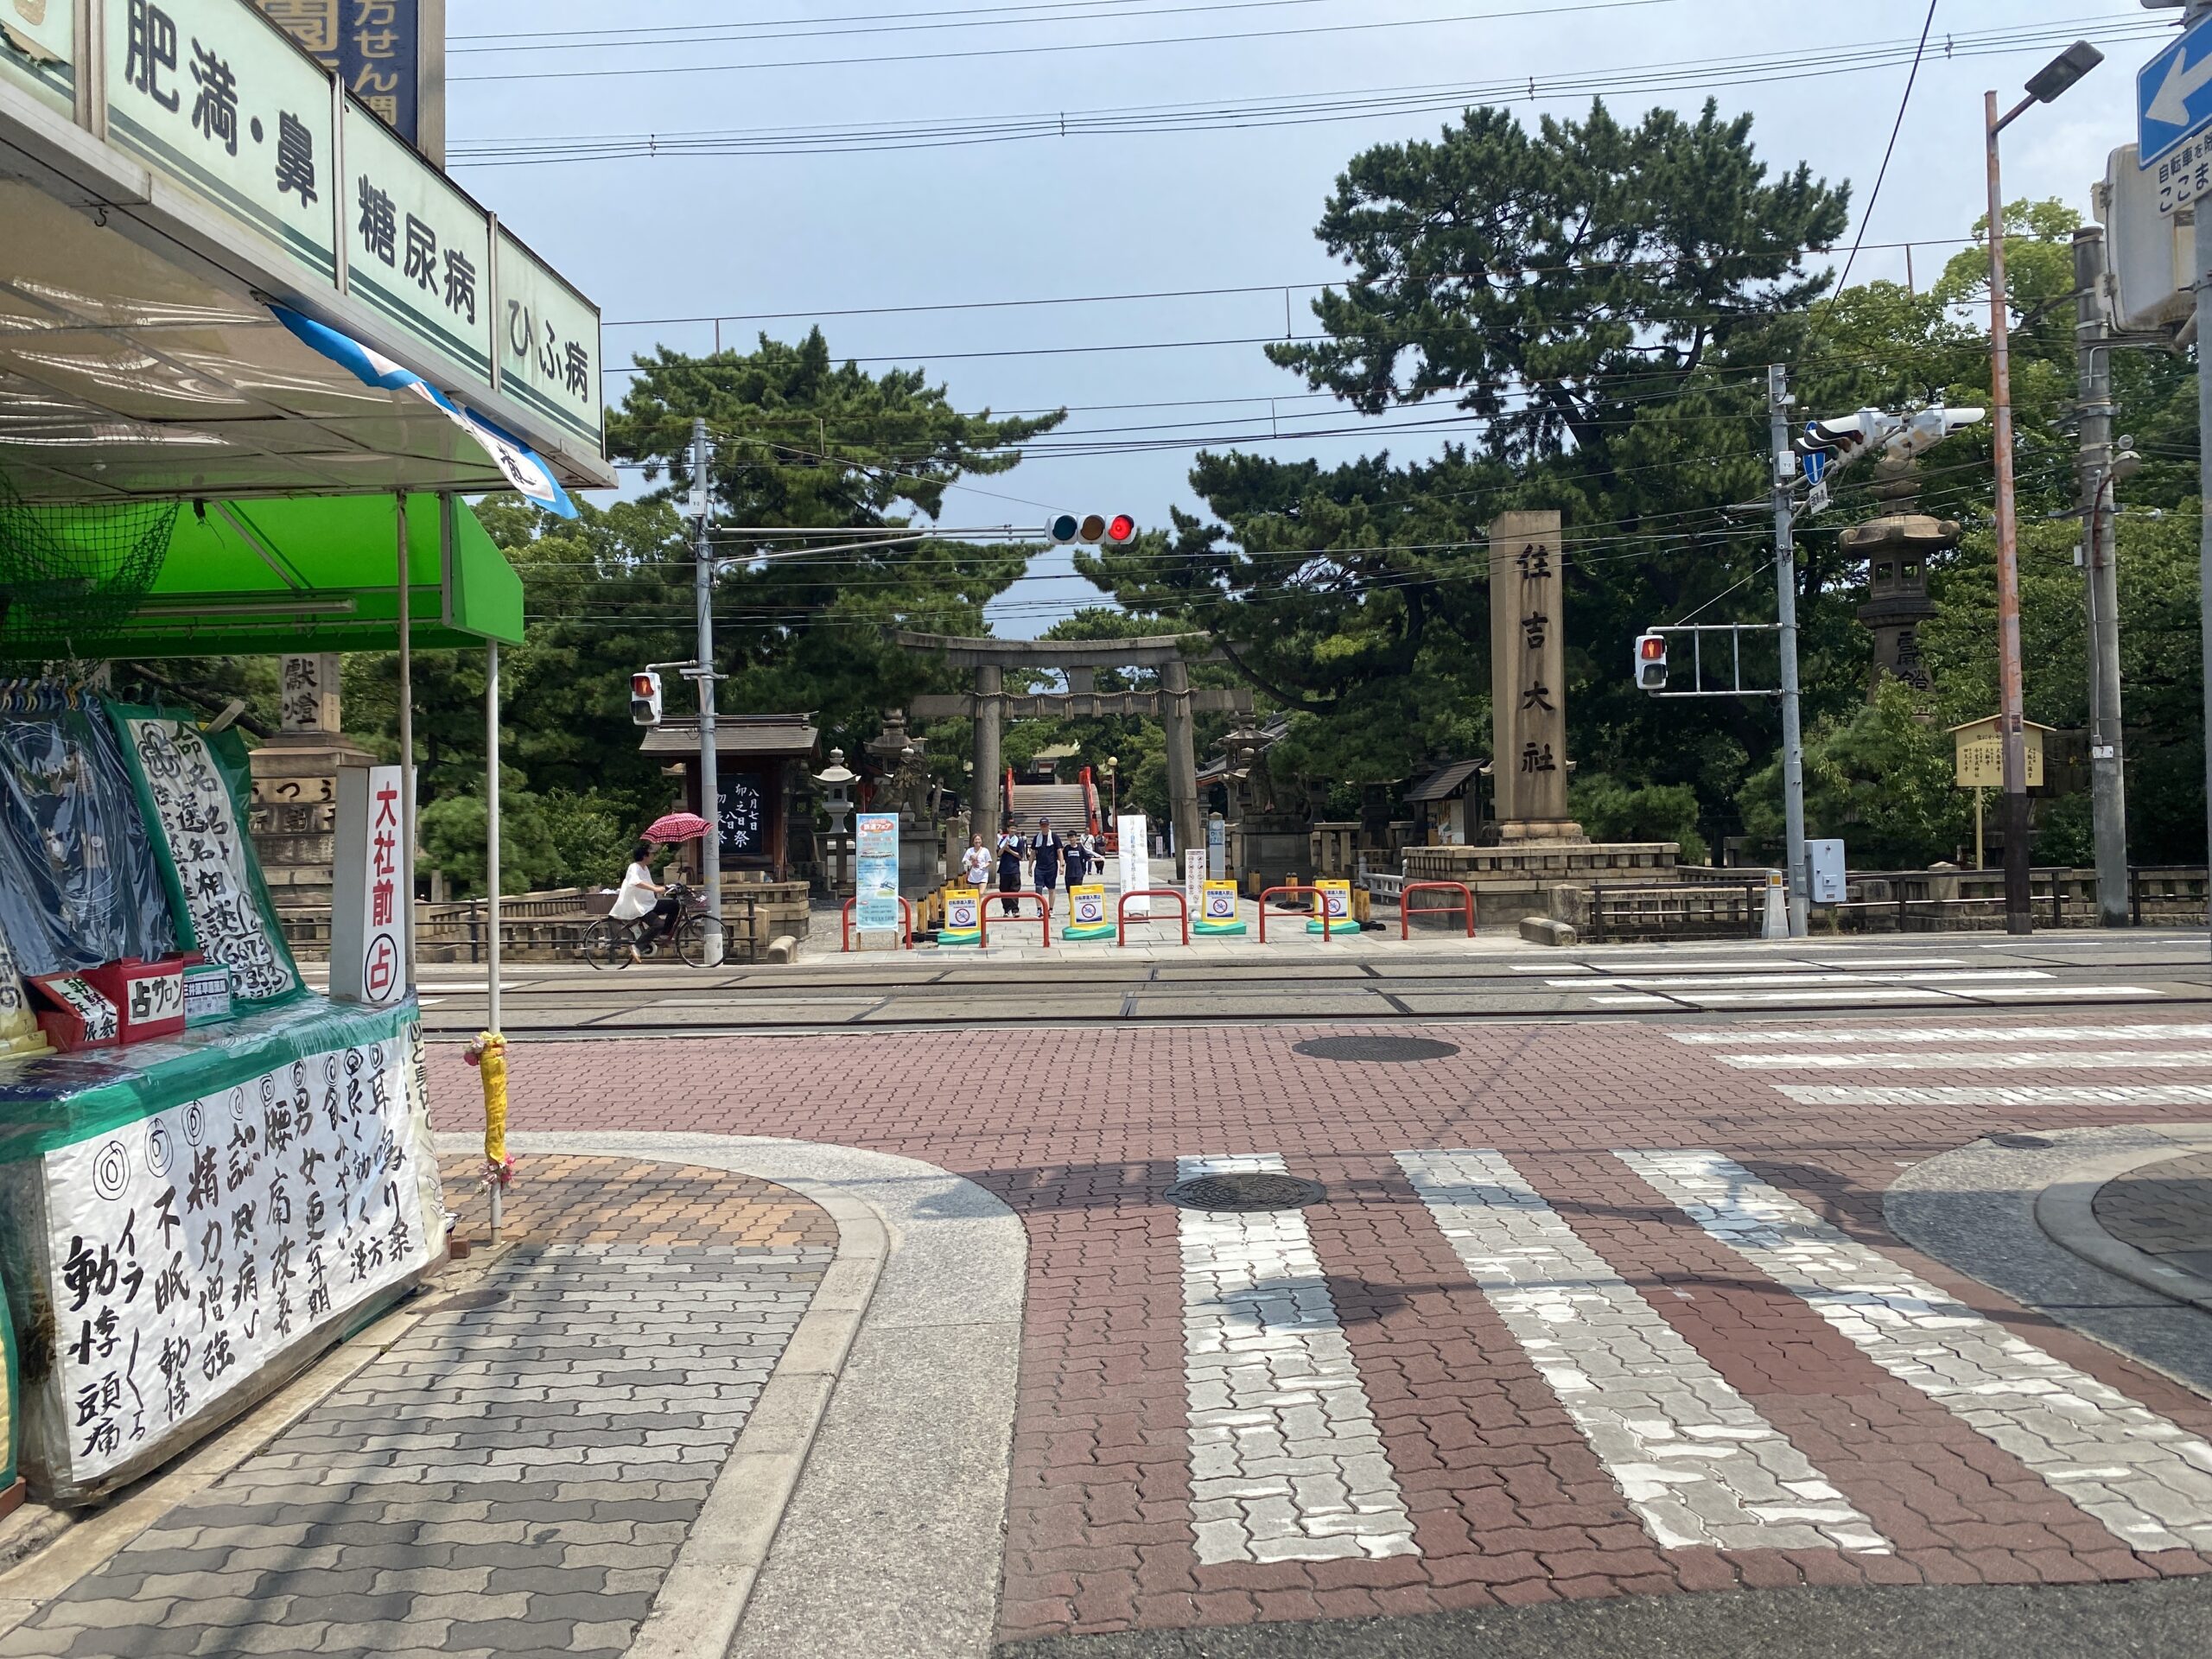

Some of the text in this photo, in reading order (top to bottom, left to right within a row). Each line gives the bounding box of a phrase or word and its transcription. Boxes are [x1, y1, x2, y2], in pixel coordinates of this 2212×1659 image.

[125, 0, 318, 209] 肥満・鼻
[358, 173, 476, 325] 糖尿病
[508, 299, 588, 404] ひふ病
[1517, 543, 1557, 772] 住吉大社
[370, 781, 398, 990] 大社前 占
[748, 788, 760, 831] 八月七日
[131, 977, 181, 1019] 占サロン
[187, 1146, 236, 1381] 精力増強
[264, 1100, 296, 1338] 腰痛改善
[295, 1088, 332, 1322] 男女更年期
